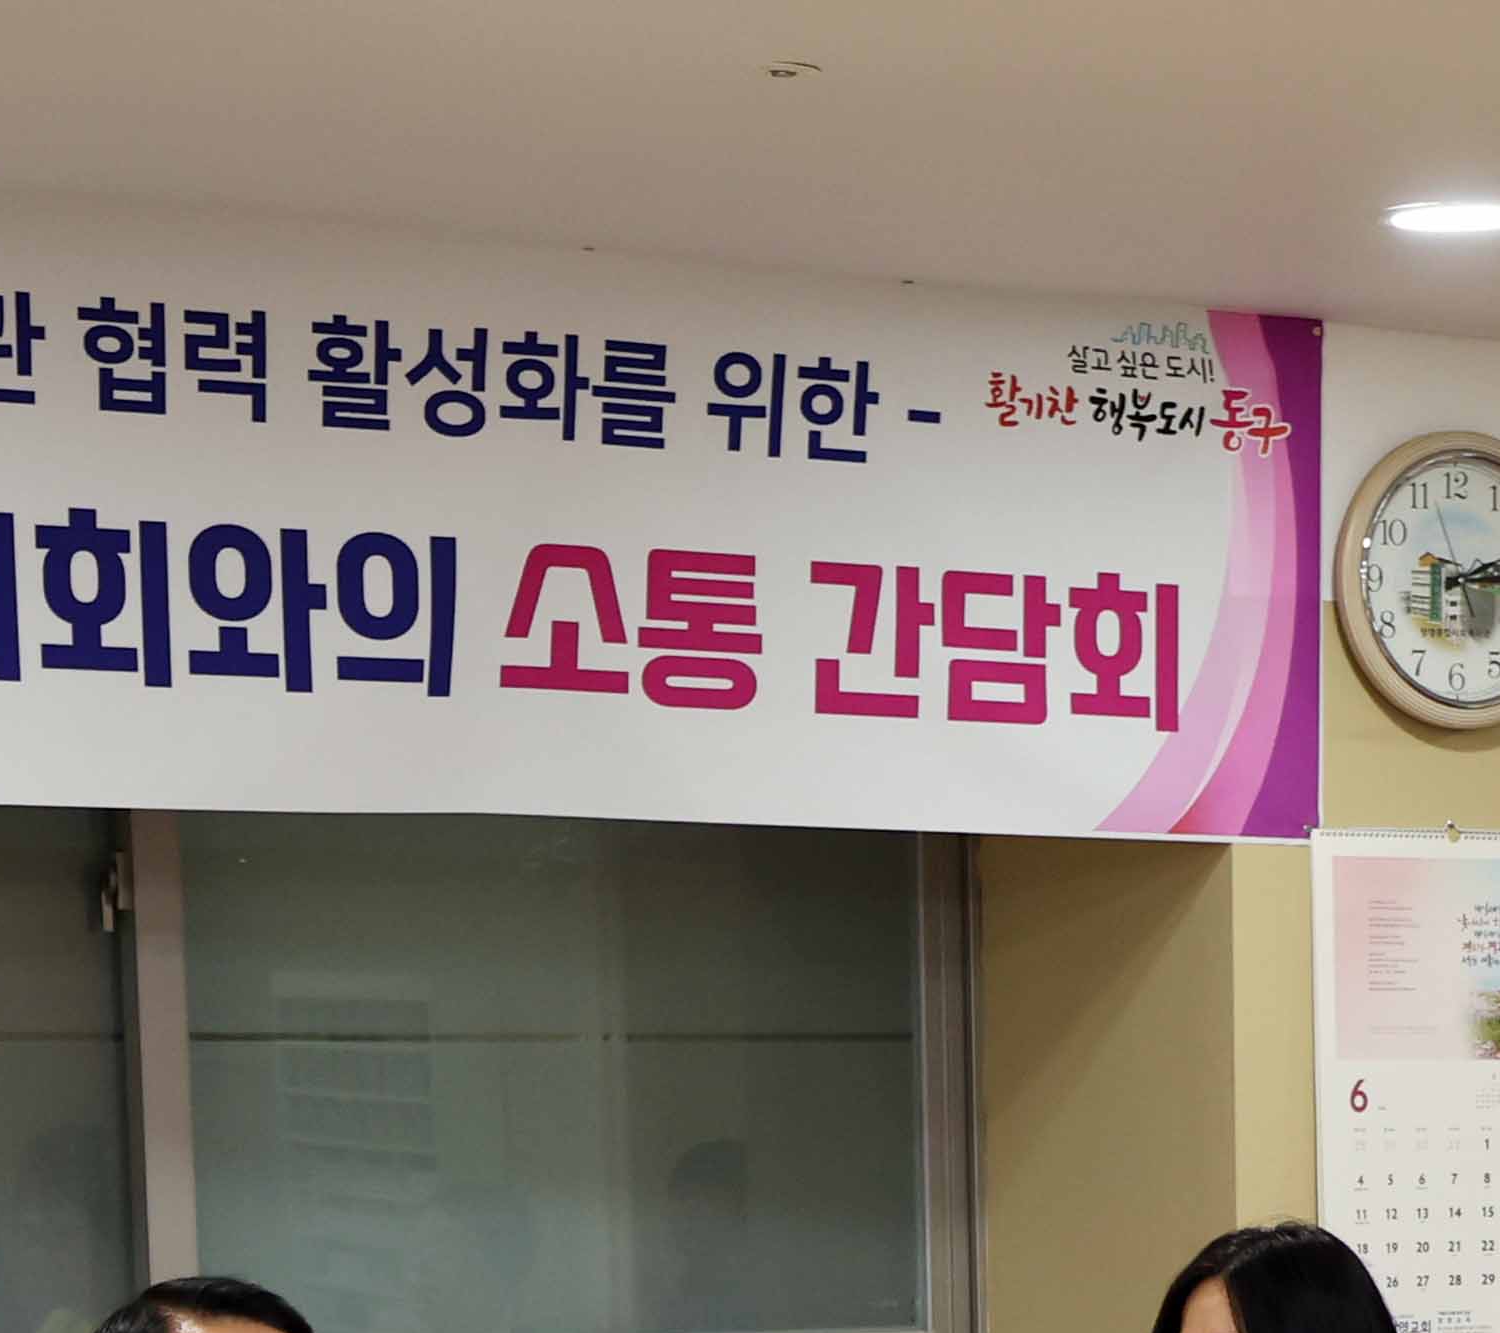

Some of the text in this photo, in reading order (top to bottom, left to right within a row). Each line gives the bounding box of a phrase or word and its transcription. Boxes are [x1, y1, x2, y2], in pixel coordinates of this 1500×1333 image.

[1068, 344, 1216, 384] 살고 싶은 도시!
[77, 293, 268, 424] 협력
[307, 315, 676, 449] 활성화를
[707, 352, 879, 463] 위한
[985, 371, 1290, 455] 활기찬 행복도시 동구
[1410, 481, 1428, 510] 11
[1443, 471, 1469, 500] 12
[1490, 484, 1499, 511] 1
[1380, 519, 1407, 546] 10
[1367, 566, 1383, 592] 9
[500, 544, 763, 710] 소통
[810, 561, 1180, 733] 간담회
[1379, 611, 1396, 639] 8
[1411, 649, 1427, 676] 7
[1448, 662, 1466, 690] 6
[1349, 1079, 1368, 1113] 6
[1484, 1138, 1490, 1150] 1
[1357, 1174, 1364, 1186] 4
[1387, 1173, 1394, 1186] 5
[1418, 1173, 1426, 1185] 6
[1451, 1172, 1458, 1185] 7
[1483, 1172, 1491, 1184] 8
[1356, 1209, 1367, 1220] 11
[1386, 1208, 1398, 1220] 12
[1416, 1207, 1429, 1219] 13
[1448, 1207, 1462, 1218] 14
[1482, 1206, 1495, 1218] 15
[1357, 1243, 1368, 1254] 18
[1386, 1242, 1398, 1254] 19
[1416, 1241, 1429, 1253] 20
[1448, 1241, 1461, 1252] 21
[1481, 1240, 1495, 1251] 22
[1386, 1276, 1399, 1288] 26
[1416, 1275, 1430, 1287] 27
[1448, 1274, 1462, 1286] 28
[1481, 1273, 1496, 1285] 29
